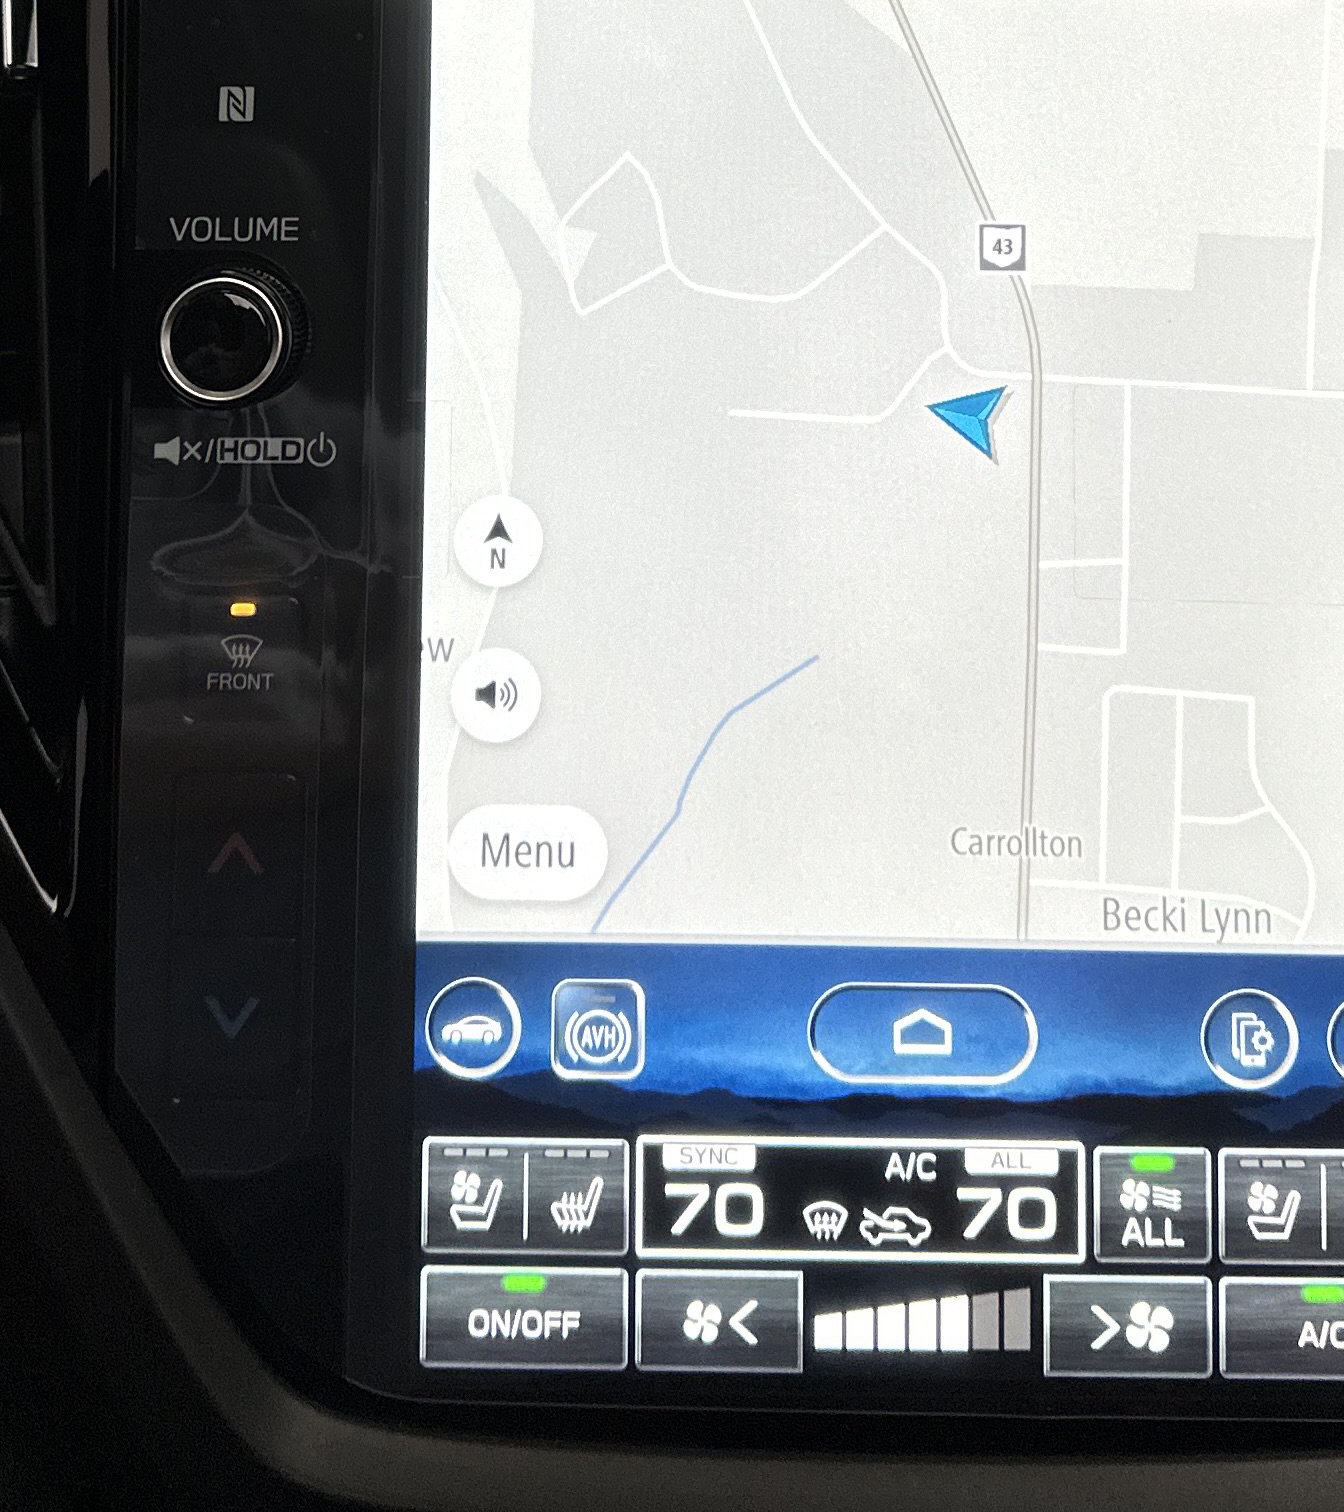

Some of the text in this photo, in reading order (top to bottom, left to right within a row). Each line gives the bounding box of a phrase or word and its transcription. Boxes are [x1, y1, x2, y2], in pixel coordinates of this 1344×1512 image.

[169, 216, 300, 242] VOLUME
[992, 238, 1013, 255] 43
[489, 547, 507, 570] N
[207, 672, 273, 691] FRONT
[479, 833, 577, 870] Menu
[950, 826, 1084, 859] Carrollton
[1102, 895, 1273, 944] Becki Lynn
[581, 1024, 617, 1051] AVH
[679, 1147, 740, 1167] SYNC
[884, 1152, 938, 1183] A/C
[990, 1151, 1034, 1170] ALL
[663, 1182, 766, 1237] 70
[955, 1186, 1058, 1241] 70
[1121, 1216, 1185, 1248] ALL
[466, 1308, 583, 1341] ON/OFF
